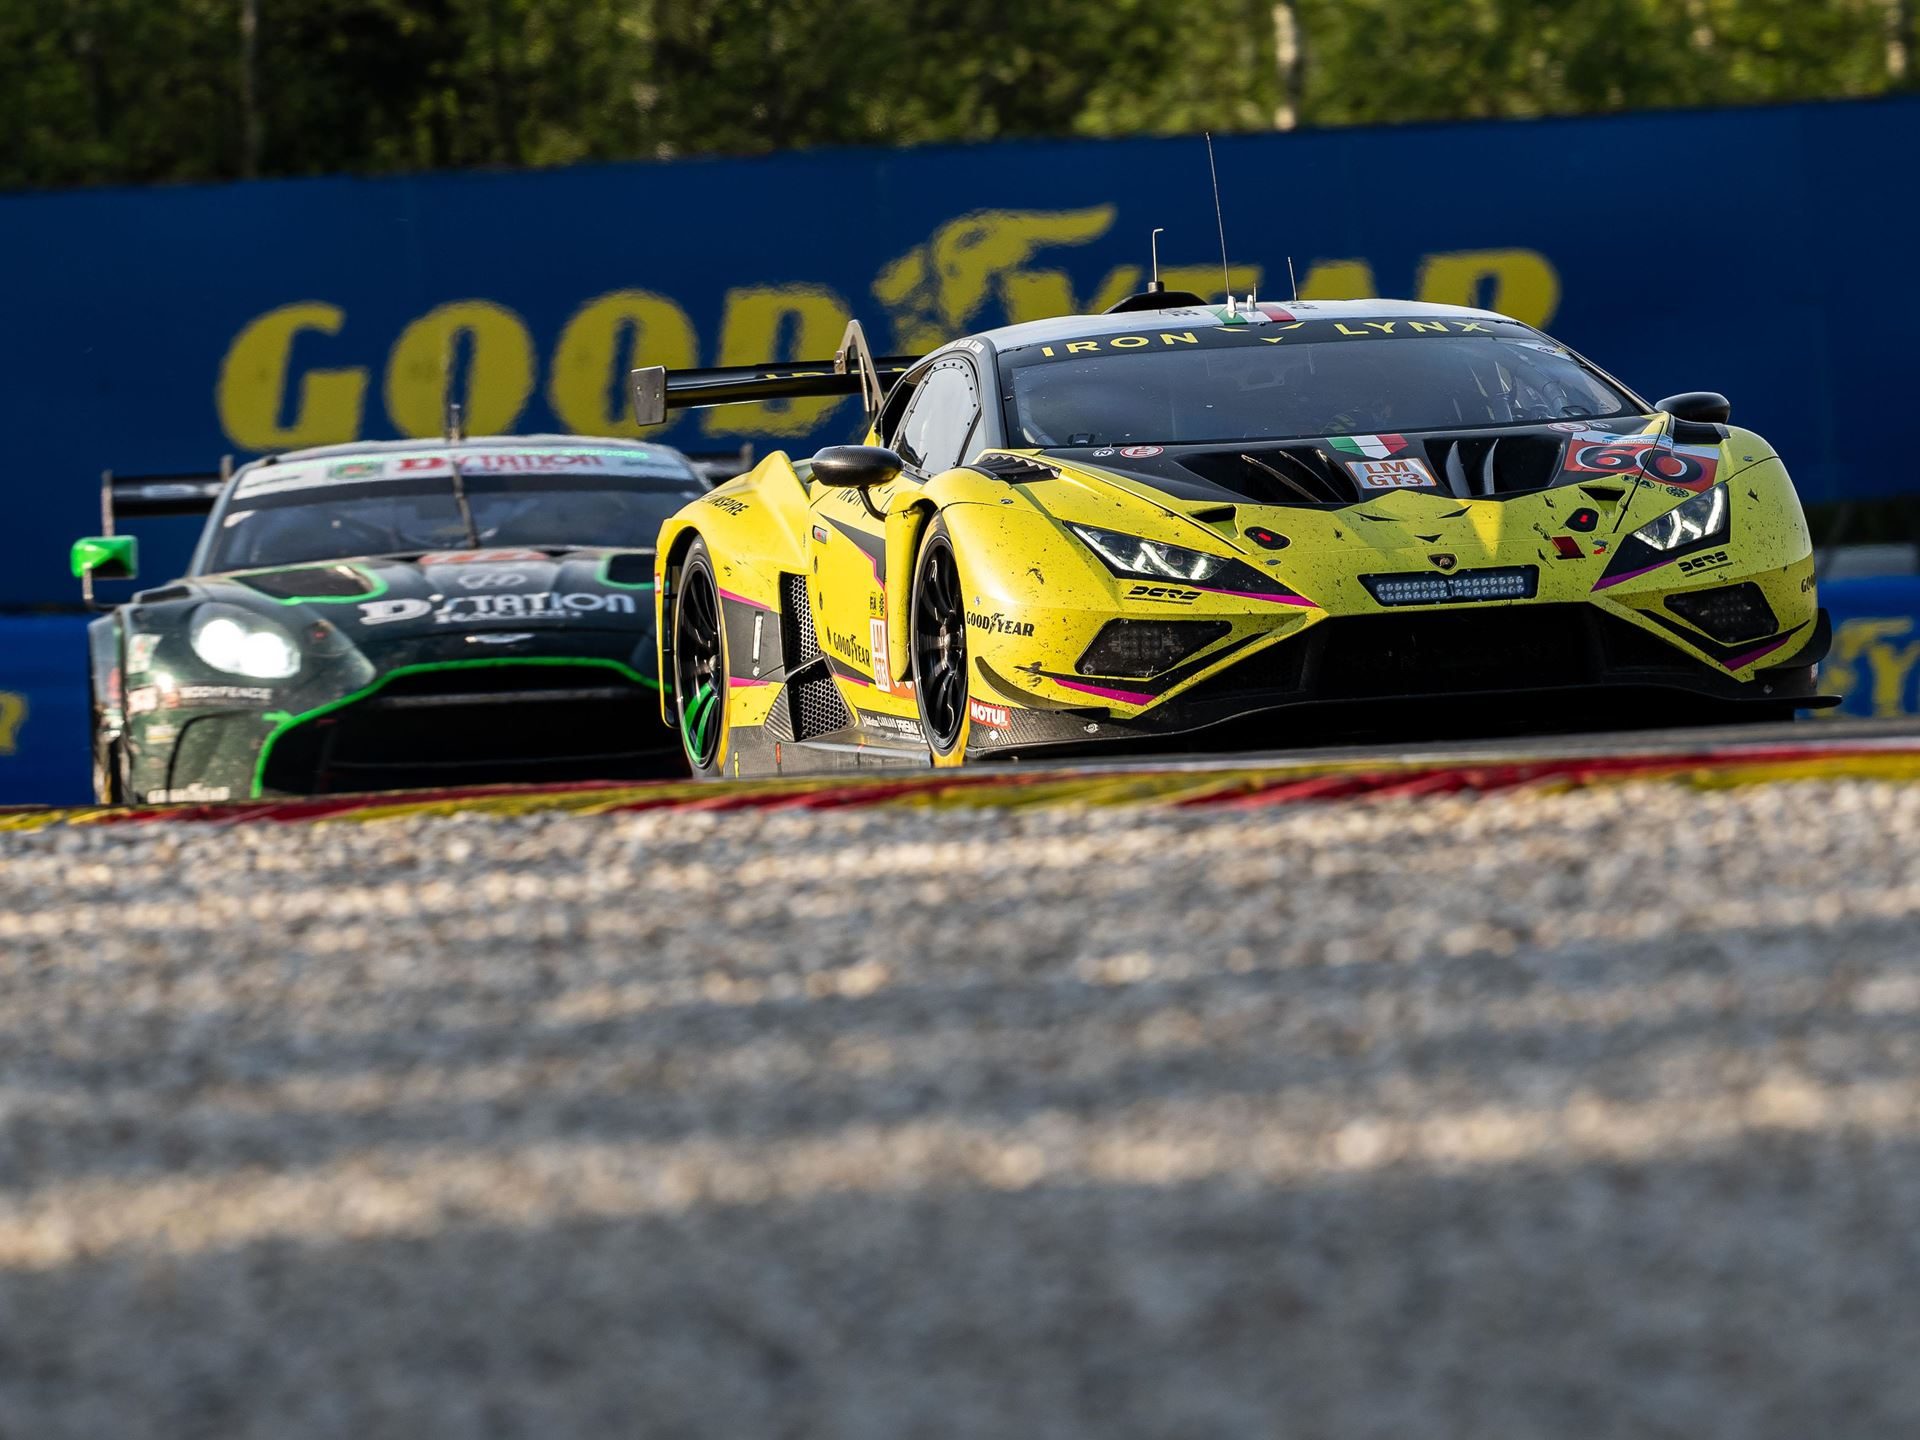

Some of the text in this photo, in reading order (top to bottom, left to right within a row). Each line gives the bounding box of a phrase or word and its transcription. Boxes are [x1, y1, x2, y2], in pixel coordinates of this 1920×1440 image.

[1041, 319, 1495, 358] IRON LYNX
[1363, 460, 1406, 474] LM
[1575, 445, 1704, 484] 60
[1366, 473, 1425, 487] GT3
[966, 611, 1034, 638] GOODYEAR
[833, 632, 871, 668] GOODYEAR
[970, 701, 1008, 726] MOTUL
